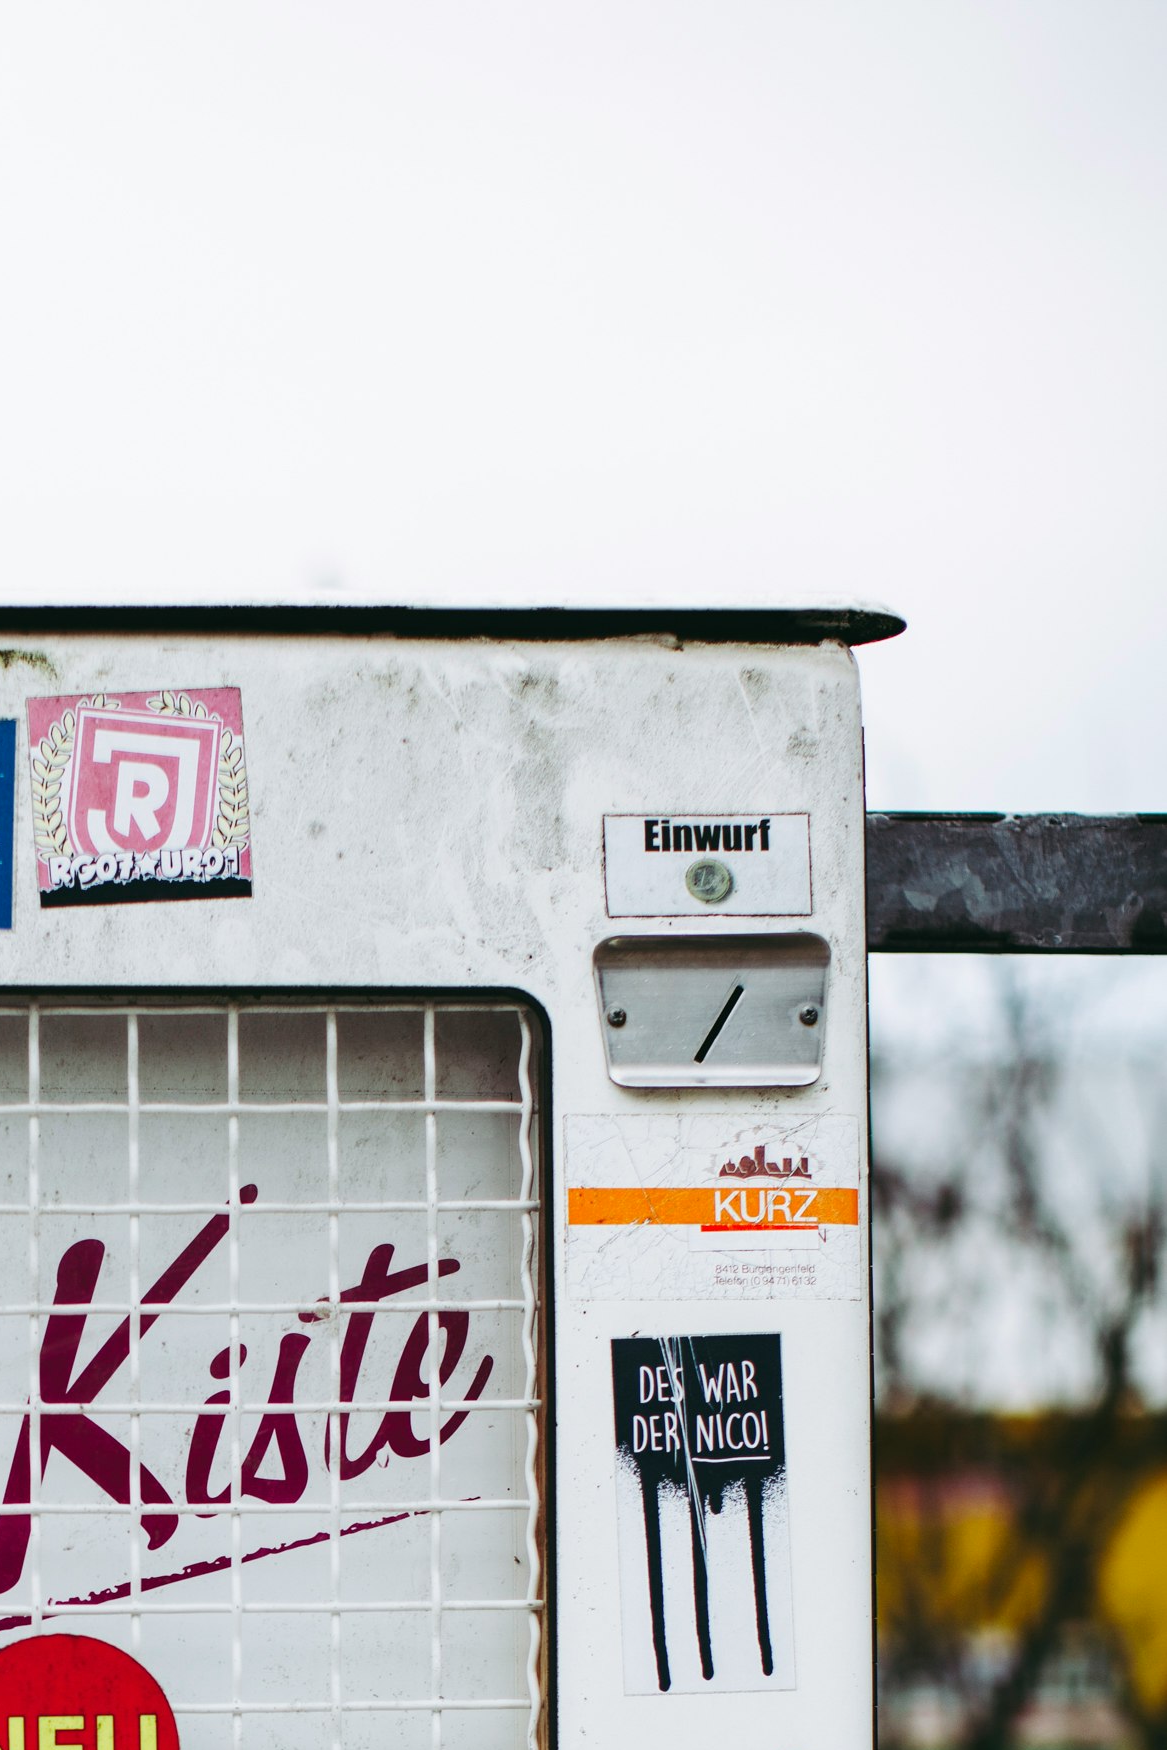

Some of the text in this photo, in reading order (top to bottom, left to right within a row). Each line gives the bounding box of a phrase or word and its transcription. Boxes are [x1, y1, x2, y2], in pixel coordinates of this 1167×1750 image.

[643, 818, 771, 853] Einwurf
[713, 1189, 818, 1223] KURZ
[638, 1360, 759, 1404] DES WAR
[633, 1410, 770, 1453] DER NICO!
